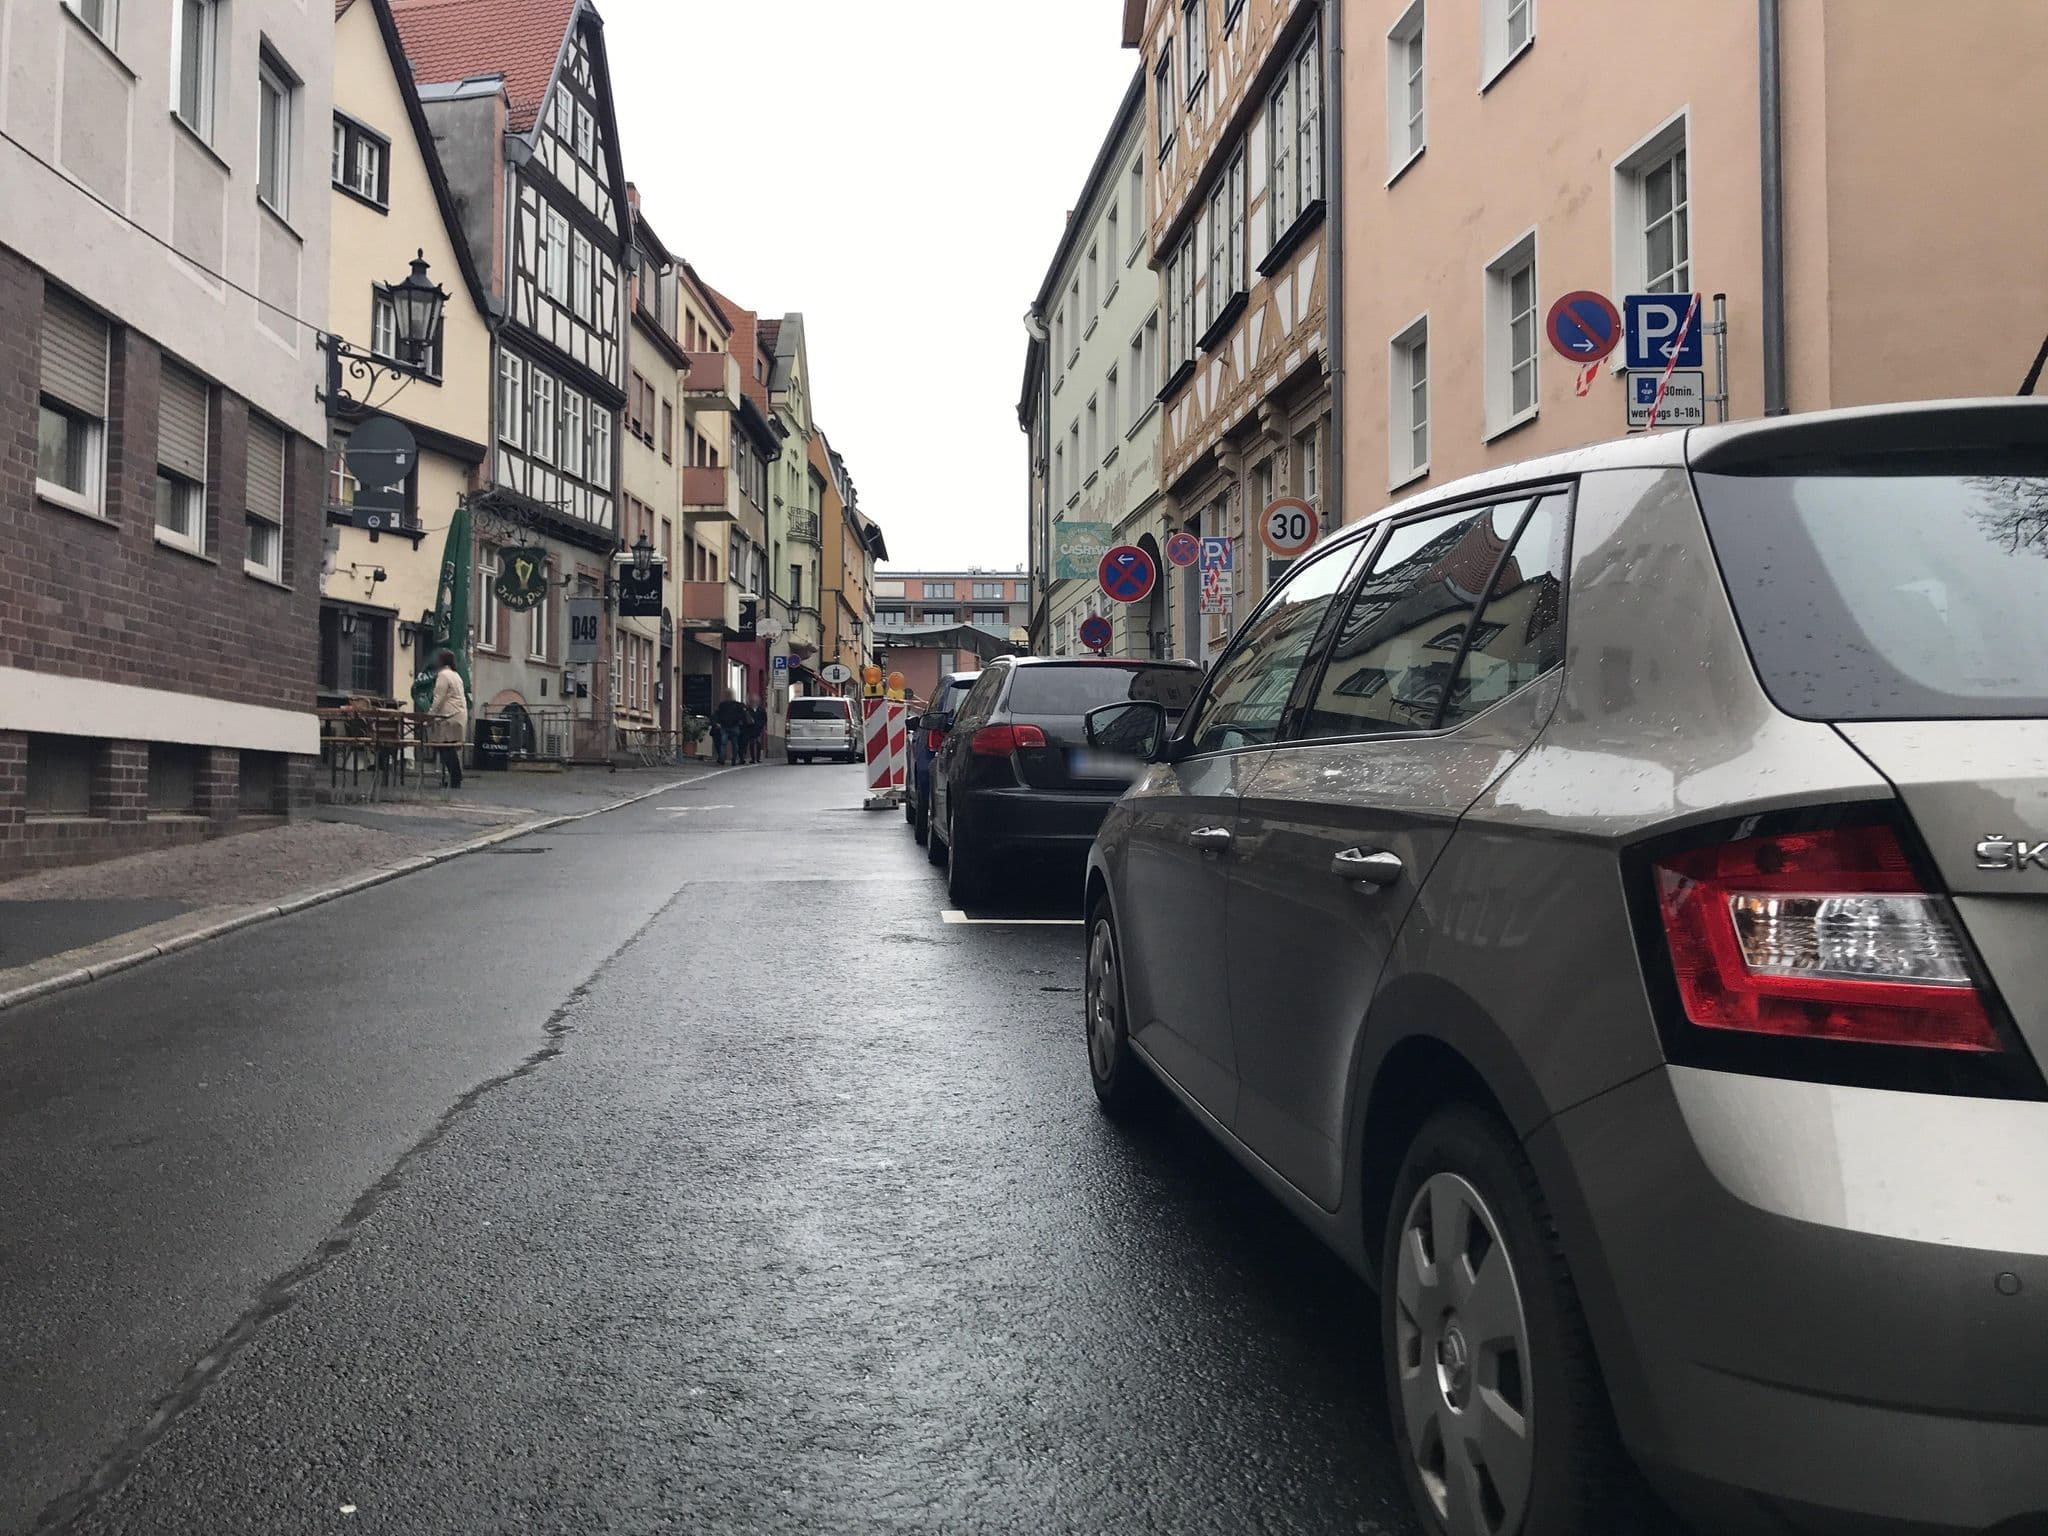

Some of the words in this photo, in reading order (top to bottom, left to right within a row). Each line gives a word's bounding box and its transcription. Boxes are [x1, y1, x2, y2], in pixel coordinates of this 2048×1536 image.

[1638, 304, 1678, 359] P
[1631, 407, 1671, 420] werkags
[1271, 513, 1306, 540] 30
[1205, 541, 1223, 566] P
[498, 585, 523, 605] Irish
[571, 615, 597, 640] D48
[775, 657, 784, 668] P
